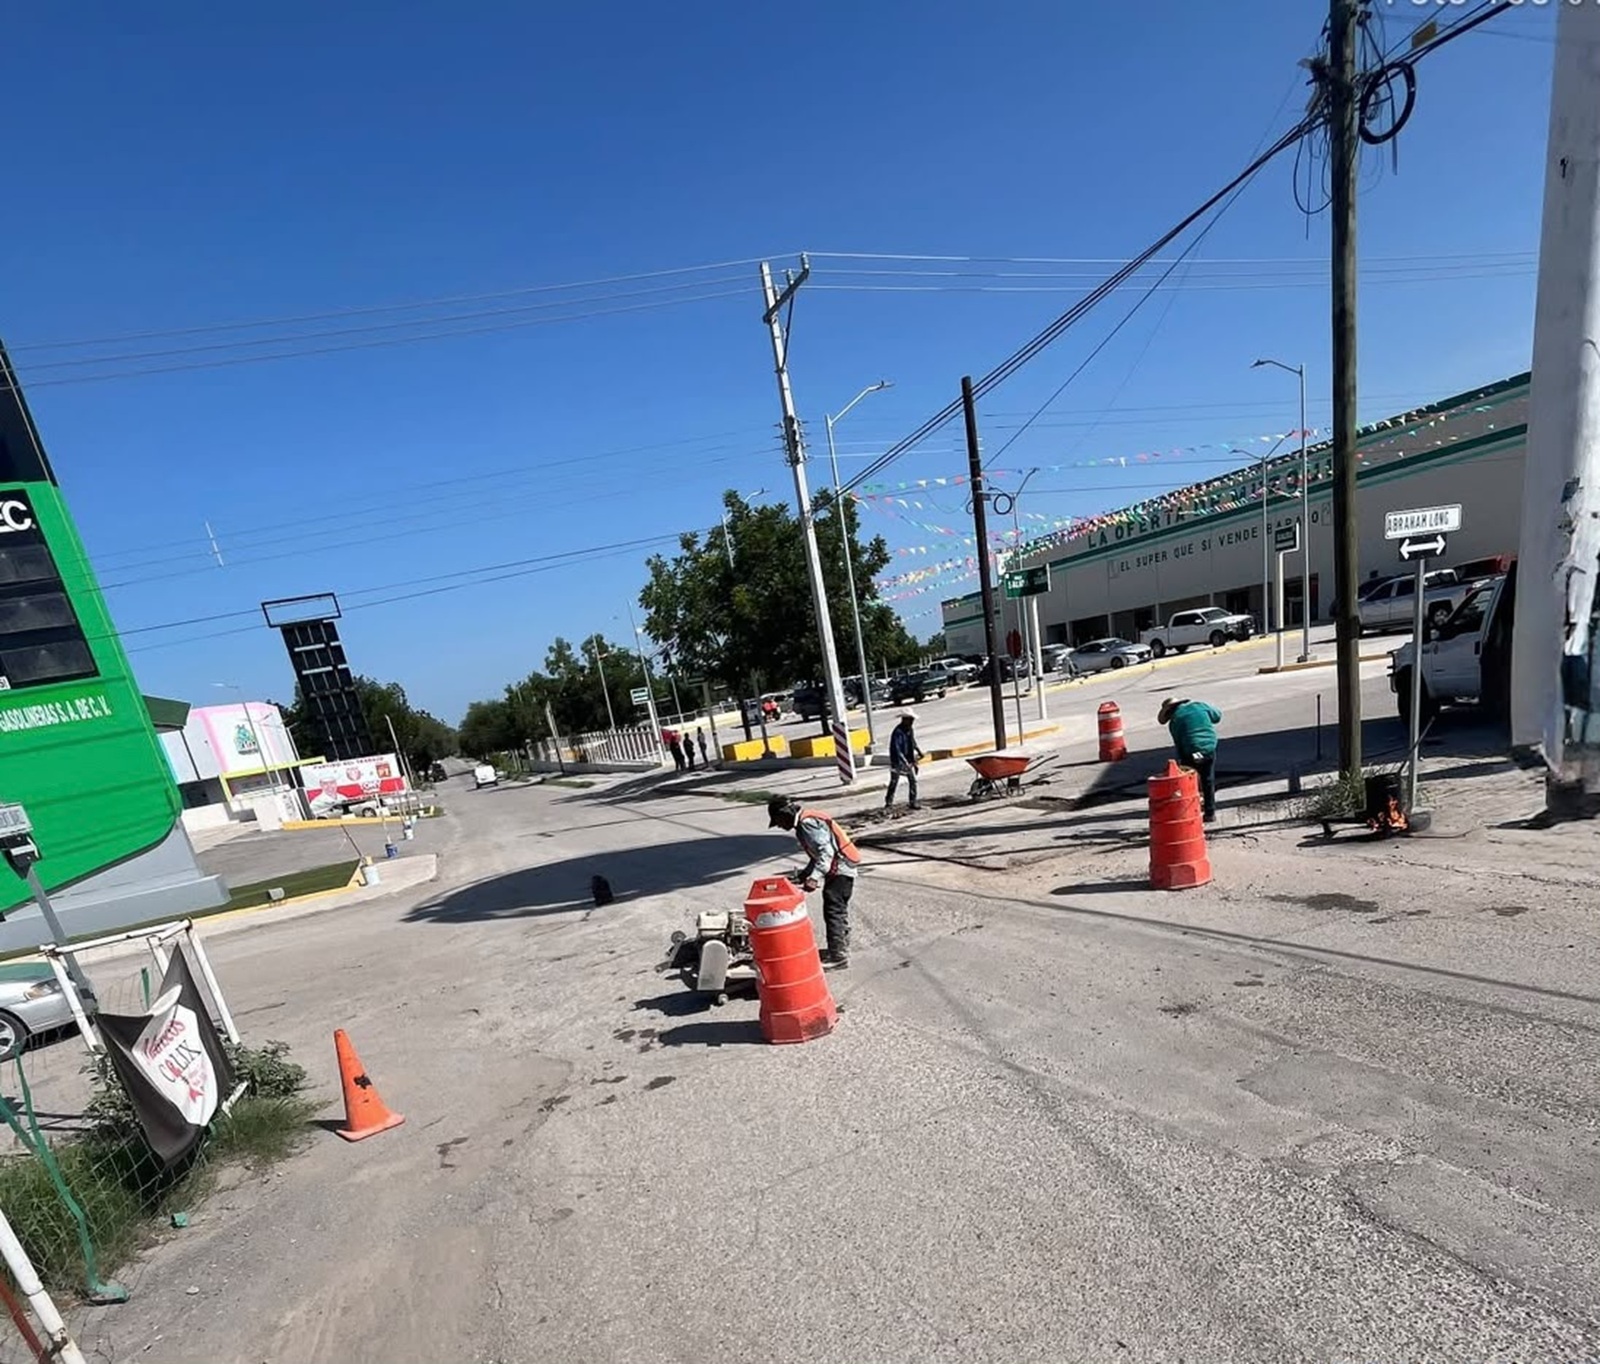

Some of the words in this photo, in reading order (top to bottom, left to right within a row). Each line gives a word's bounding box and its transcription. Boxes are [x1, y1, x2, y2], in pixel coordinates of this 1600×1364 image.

[1088, 530, 1108, 549] LA
[1115, 506, 1186, 540] OFERTA
[1121, 561, 1131, 572] EL
[1137, 554, 1168, 568] SUPER
[1173, 543, 1194, 558] QUE
[1219, 526, 1258, 547] VENDE
[1267, 511, 1319, 535] BARAO
[1387, 513, 1427, 532] ABRAHAM
